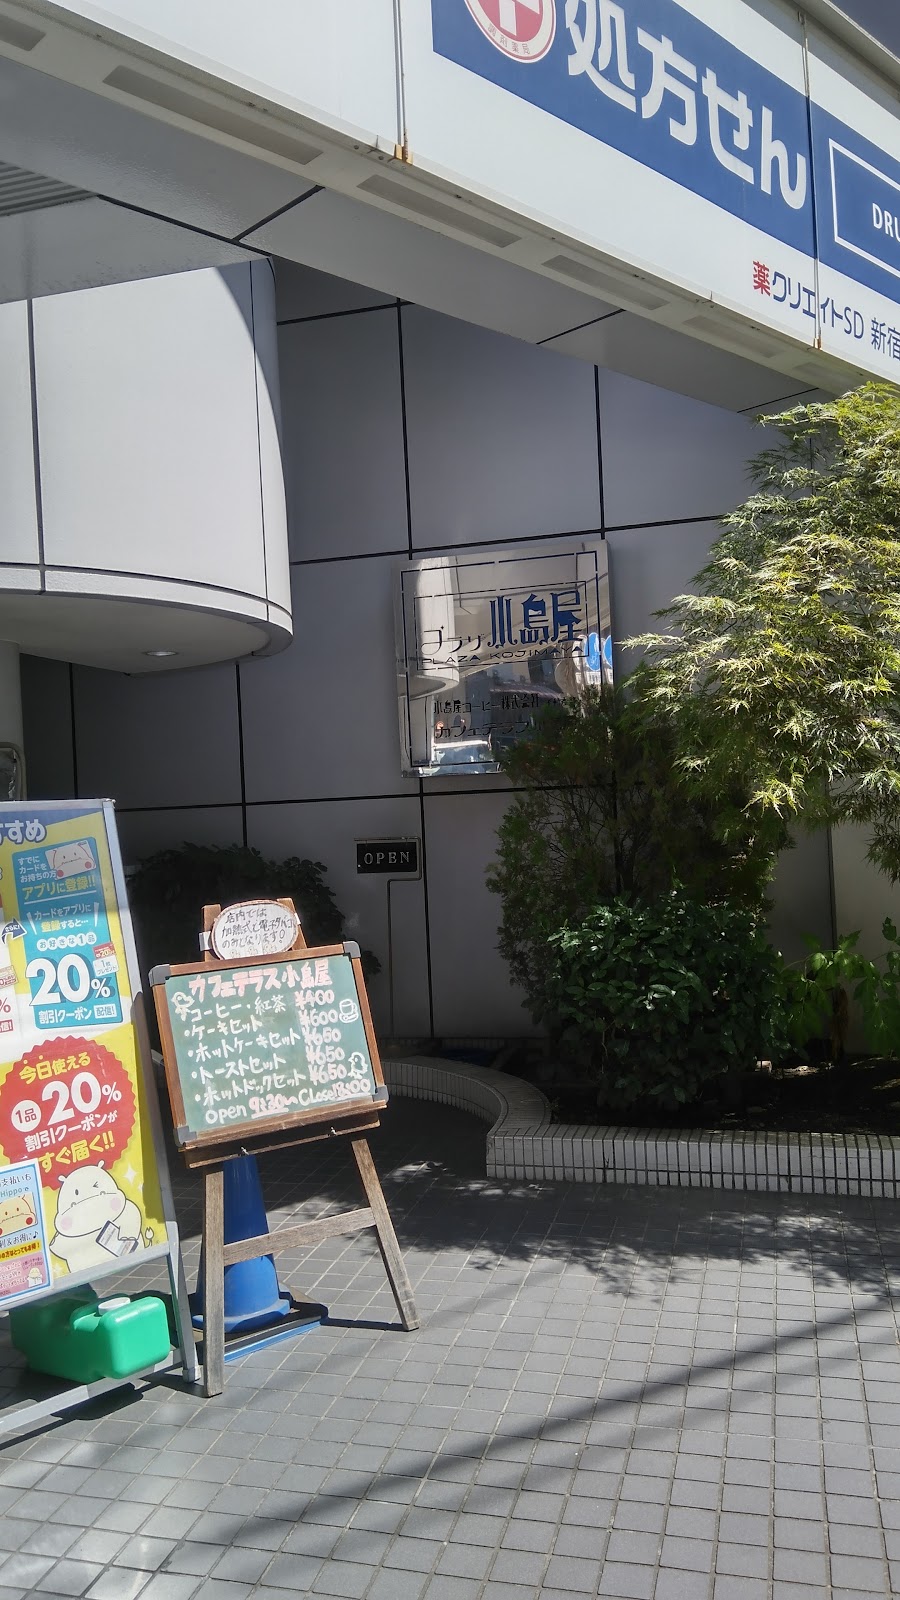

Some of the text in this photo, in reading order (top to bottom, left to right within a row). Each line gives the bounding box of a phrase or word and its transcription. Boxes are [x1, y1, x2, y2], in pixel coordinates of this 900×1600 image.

[564, 0, 806, 210] 処方せん
[421, 644, 584, 665] PLAZA KOJIMAYA
[0, 819, 47, 845] すめ
[17, 855, 40, 865] すでに
[363, 851, 410, 865] OPEN
[19, 863, 48, 874] カードを
[20, 869, 58, 884] お持ちの方
[34, 903, 92, 922] カードをアプリに
[225, 908, 267, 924] 店内では
[26, 952, 111, 1007] 20%
[38, 1006, 93, 1025] 割引クーポン
[19, 1050, 92, 1085] 今日使える
[14, 1071, 122, 1127] 1品 20%
[24, 1110, 118, 1153] 割引クーポンが
[0, 1173, 32, 1189] 支払いも
